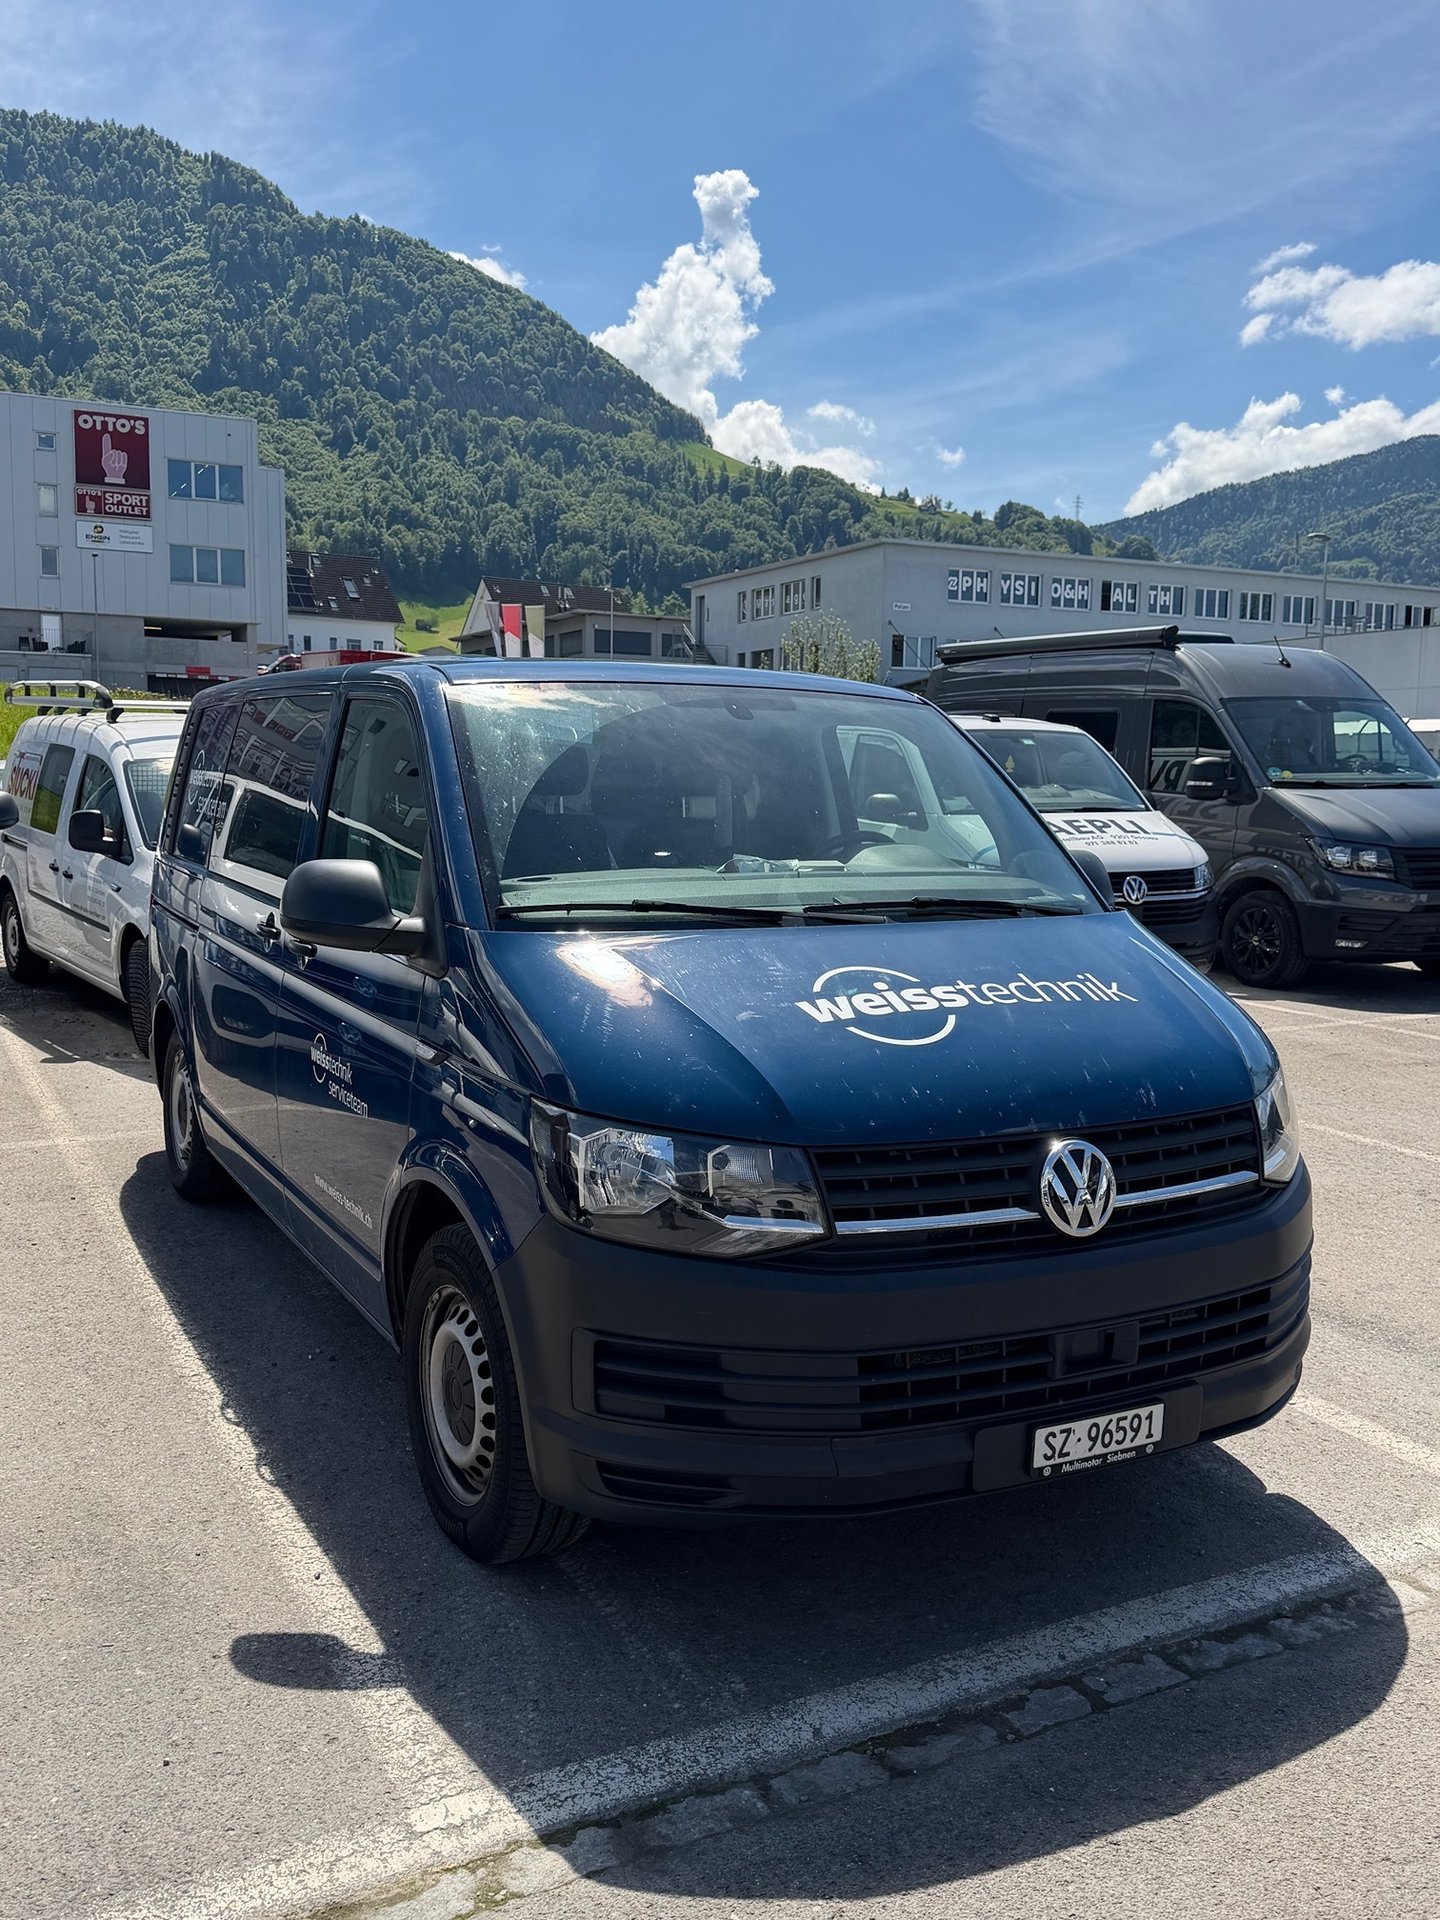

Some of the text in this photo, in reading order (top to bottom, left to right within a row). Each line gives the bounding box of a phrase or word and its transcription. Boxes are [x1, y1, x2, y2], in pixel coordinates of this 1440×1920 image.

[78, 414, 146, 435] OTTO'S
[105, 493, 148, 506] SPORT
[105, 504, 148, 515] OUTLET
[85, 533, 110, 541] ENGIN
[1046, 819, 1152, 835] AEPLI
[795, 973, 1139, 1023] weisstechnik
[310, 1045, 353, 1085] weisstechnik
[328, 1079, 369, 1119] serviceteam
[1061, 1450, 1136, 1473] Multimotor Siebnen
